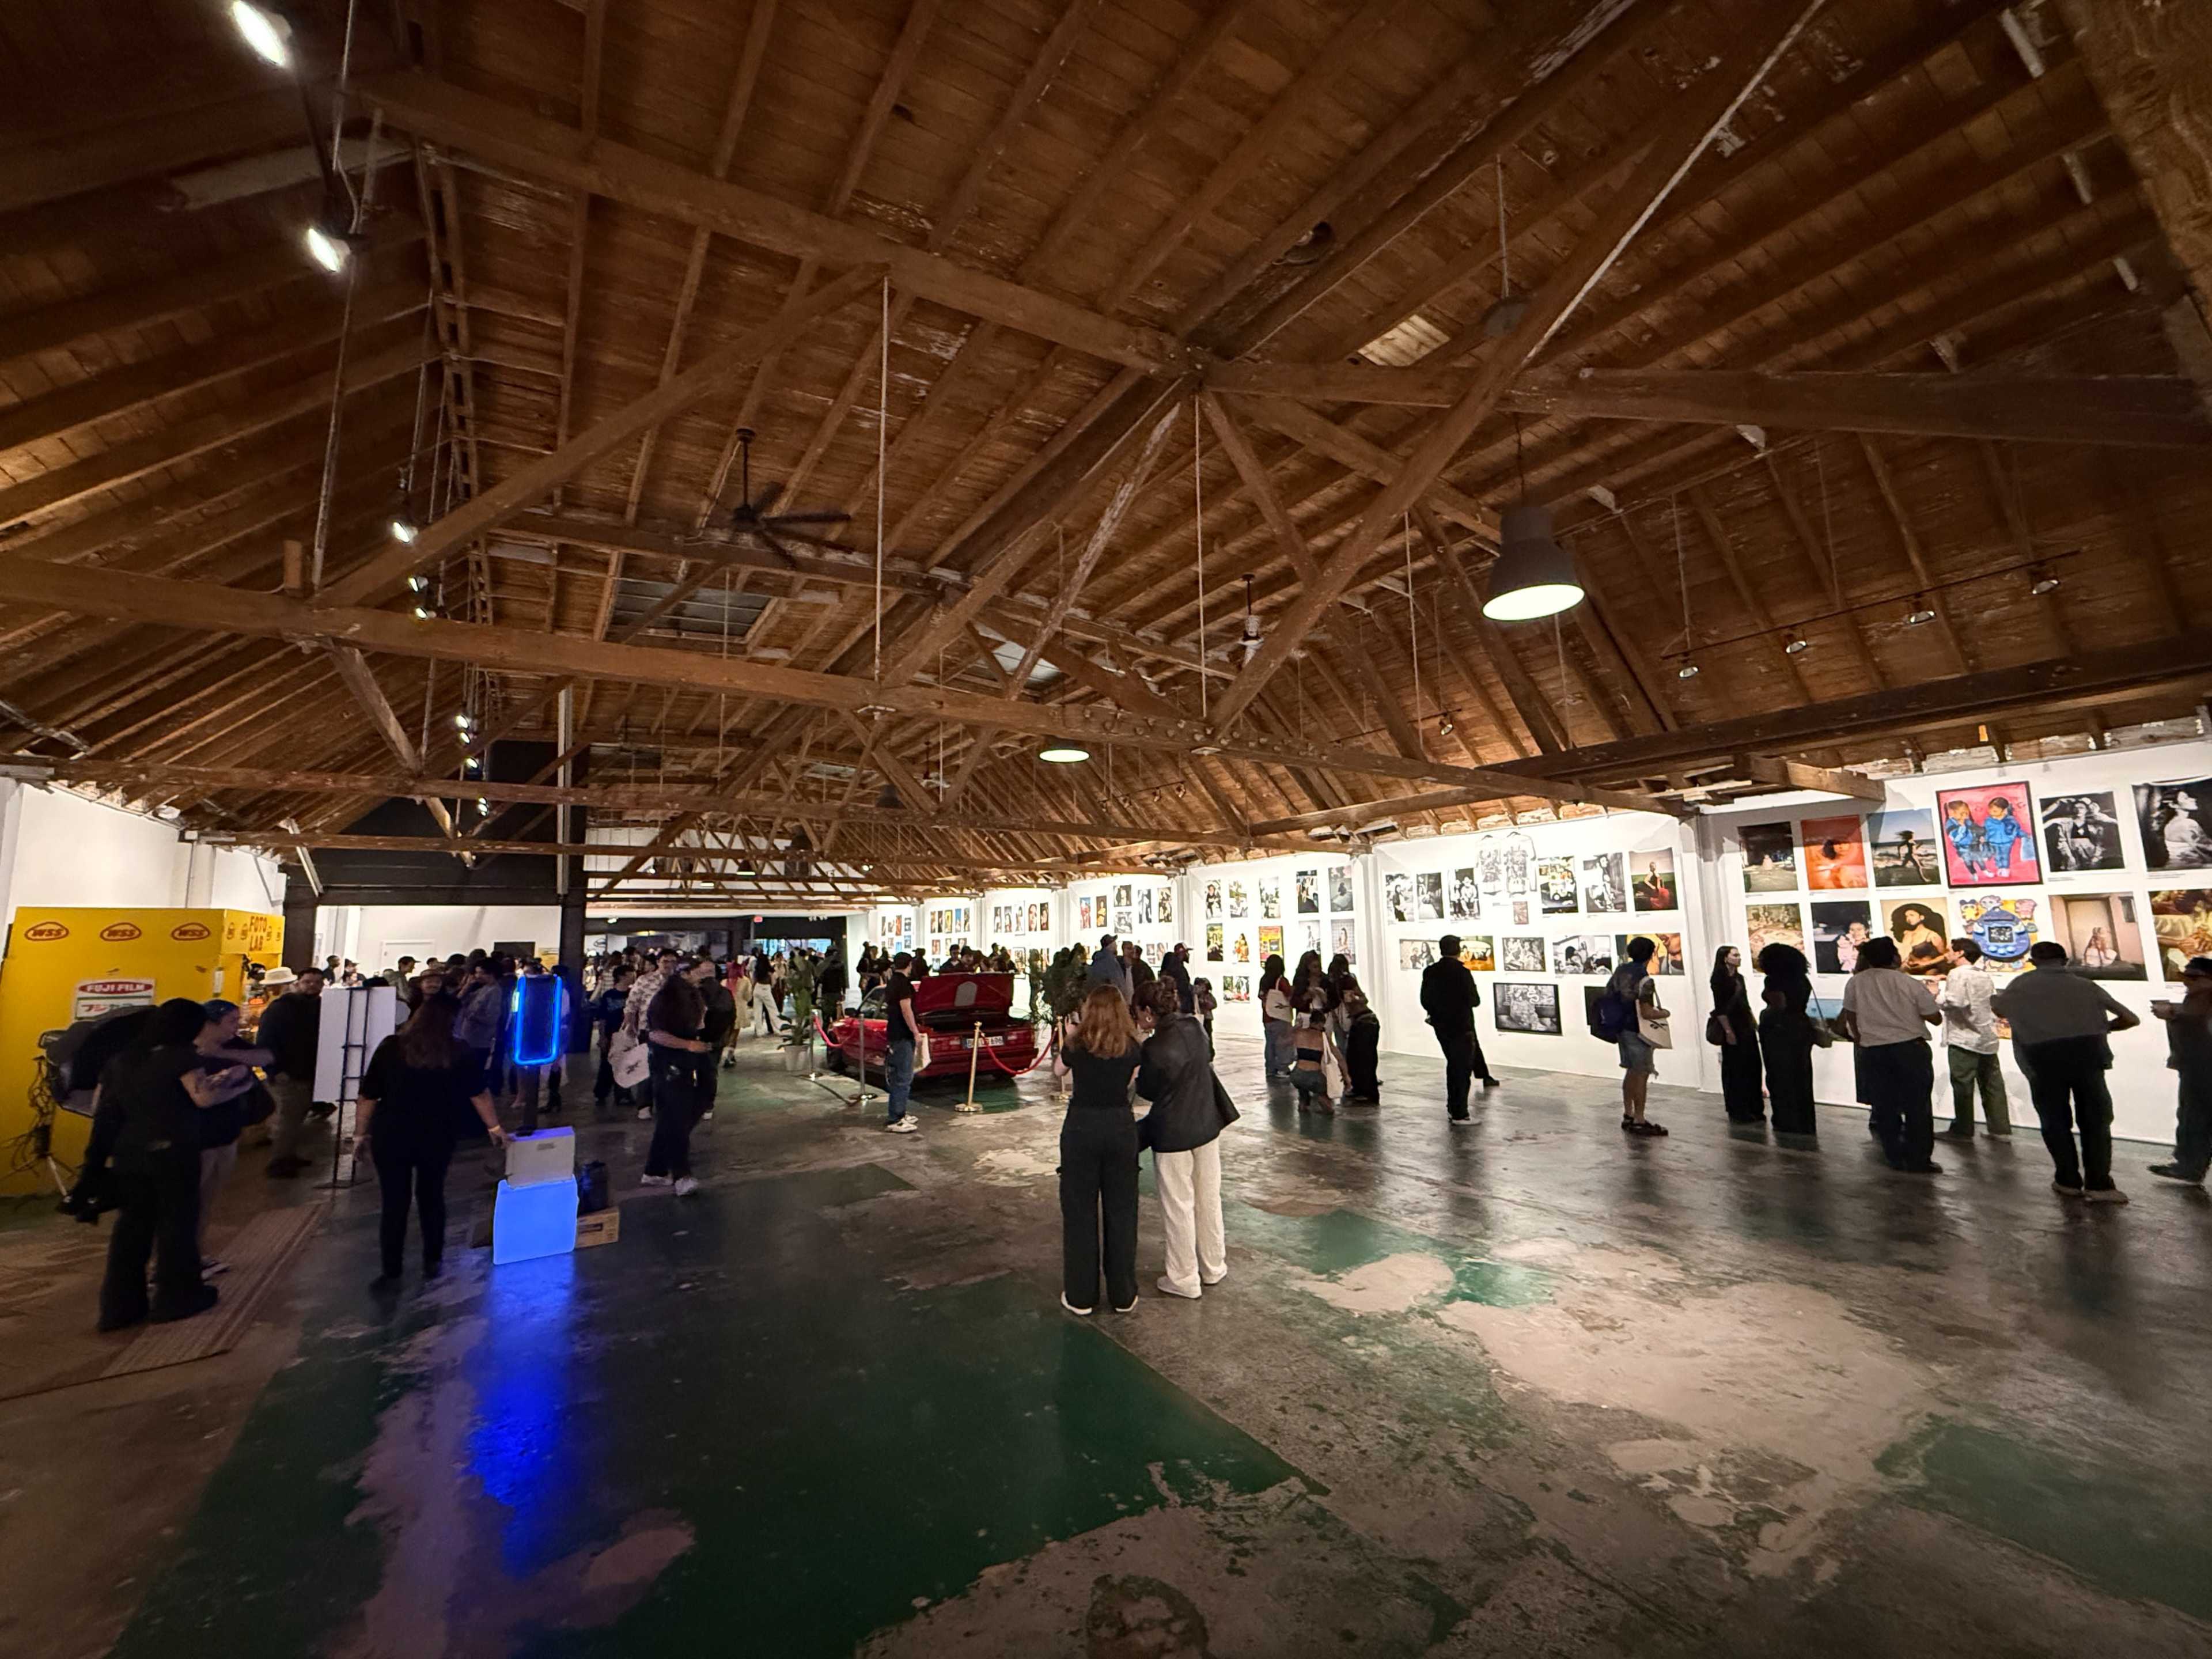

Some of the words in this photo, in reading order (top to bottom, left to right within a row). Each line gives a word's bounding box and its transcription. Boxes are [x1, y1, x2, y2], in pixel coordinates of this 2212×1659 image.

[249, 916, 267, 932] FOTO
[31, 928, 64, 937] WSS
[107, 929, 135, 937] WSS
[177, 929, 204, 937] WSS
[249, 935, 263, 951] LAB
[86, 983, 115, 993] FUJI
[117, 983, 145, 991] FILM
